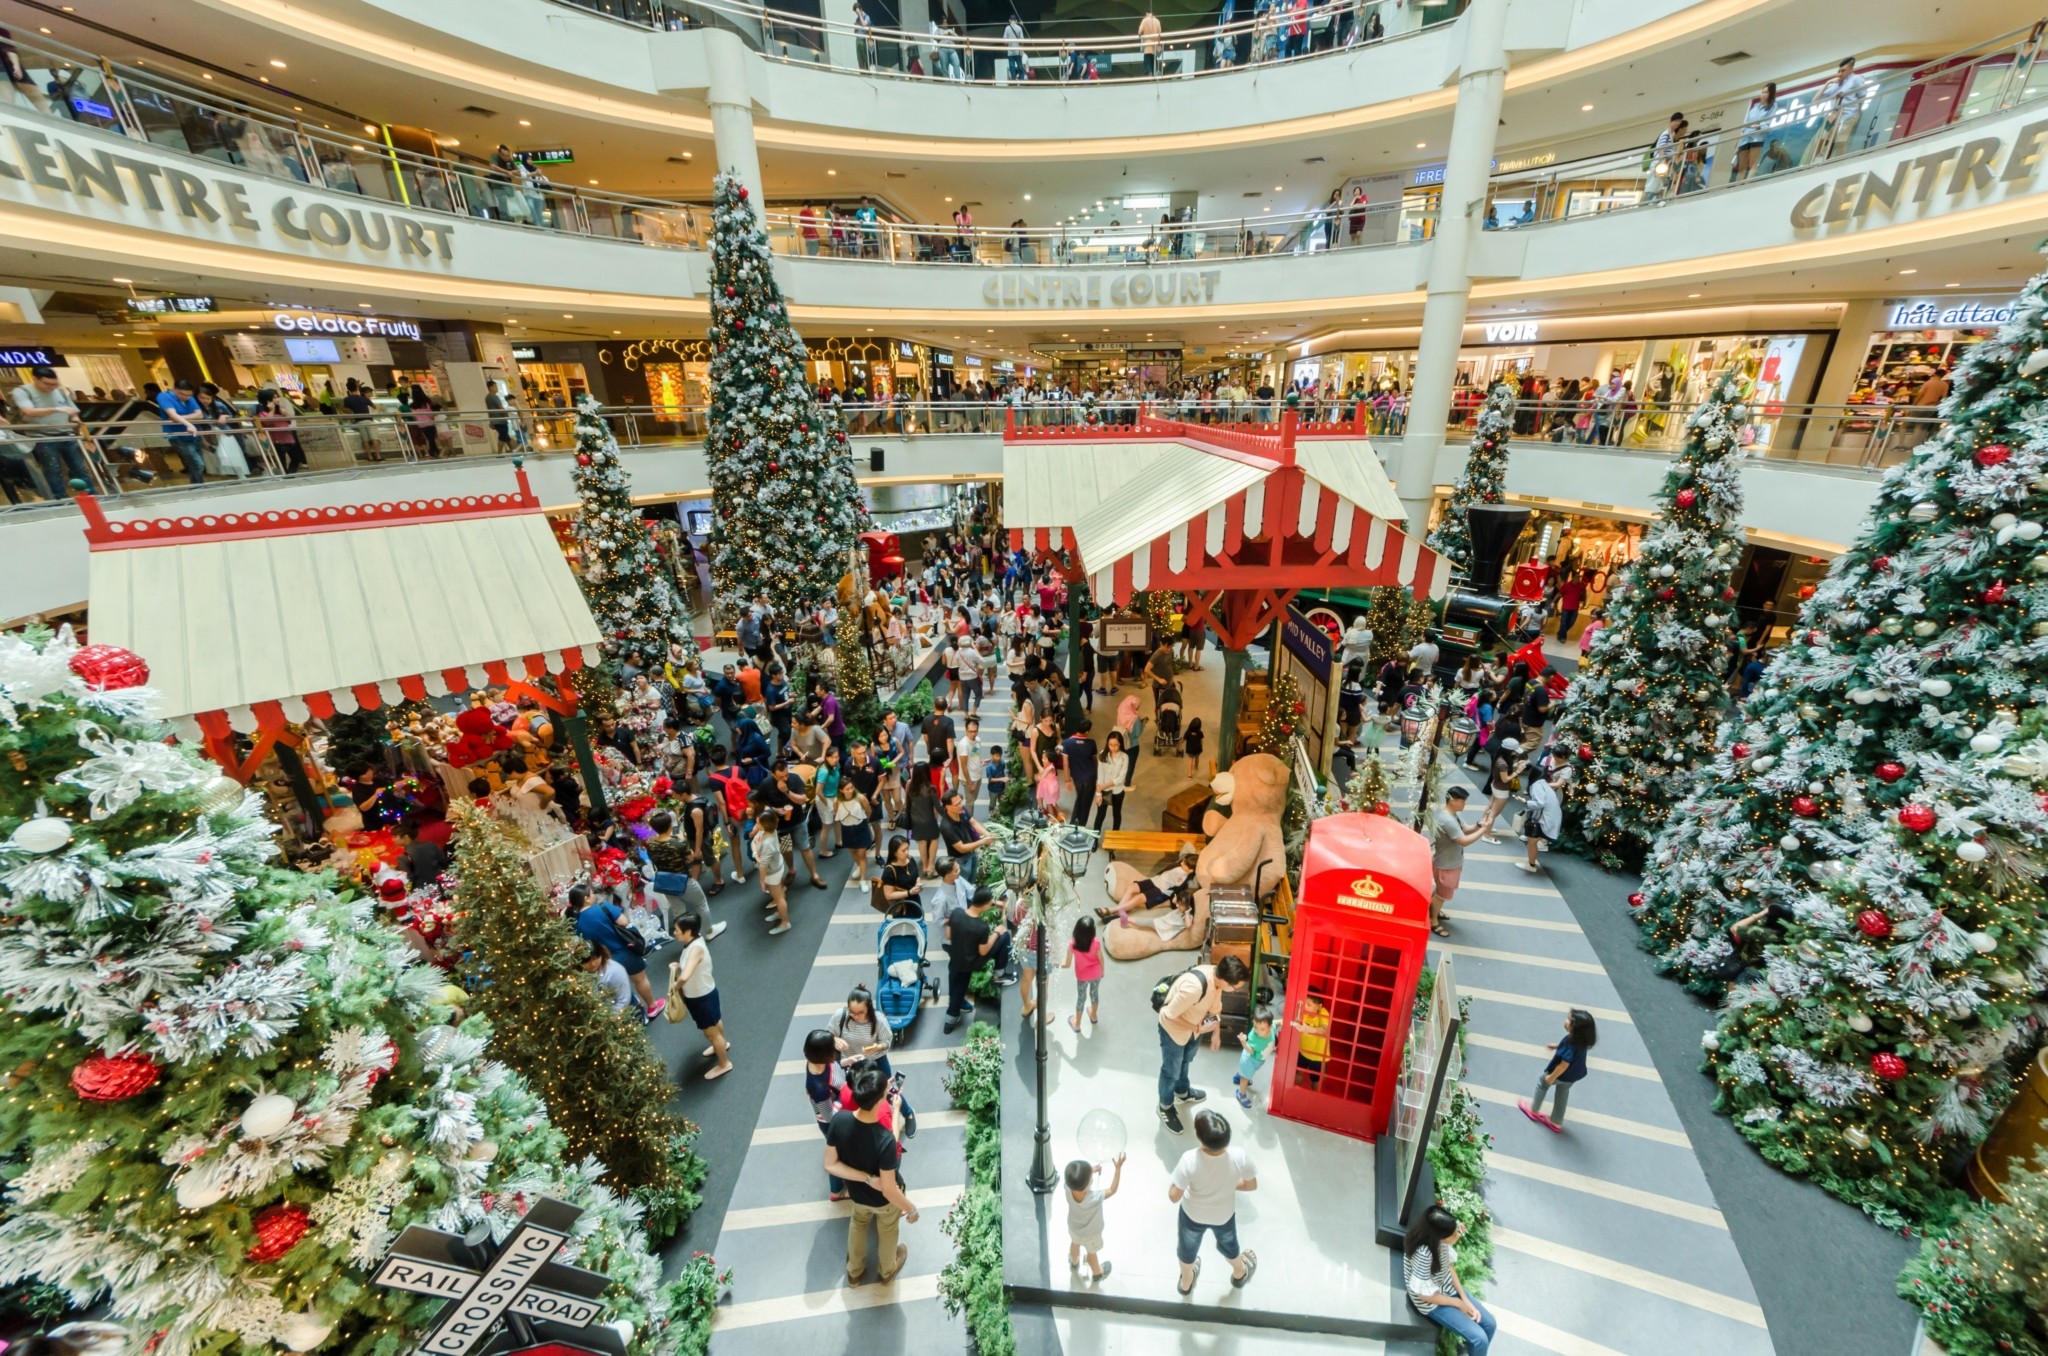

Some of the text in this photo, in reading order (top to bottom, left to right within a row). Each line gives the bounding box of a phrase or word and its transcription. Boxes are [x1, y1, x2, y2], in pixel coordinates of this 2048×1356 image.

[1789, 119, 2048, 228] CENTRE
[271, 196, 455, 260] COURT
[982, 270, 1221, 306] CENTRE COURT
[274, 313, 422, 342] Gelato Fruity
[1893, 303, 1939, 325] hat
[1485, 323, 1538, 342] VOIR
[1121, 632, 1131, 644] 1
[1287, 620, 1327, 662] MID VALLEY
[1339, 897, 1394, 912] TELEPHONE
[387, 1265, 592, 1322] RAIL ROAD
[438, 1235, 552, 1350] CROSSING
